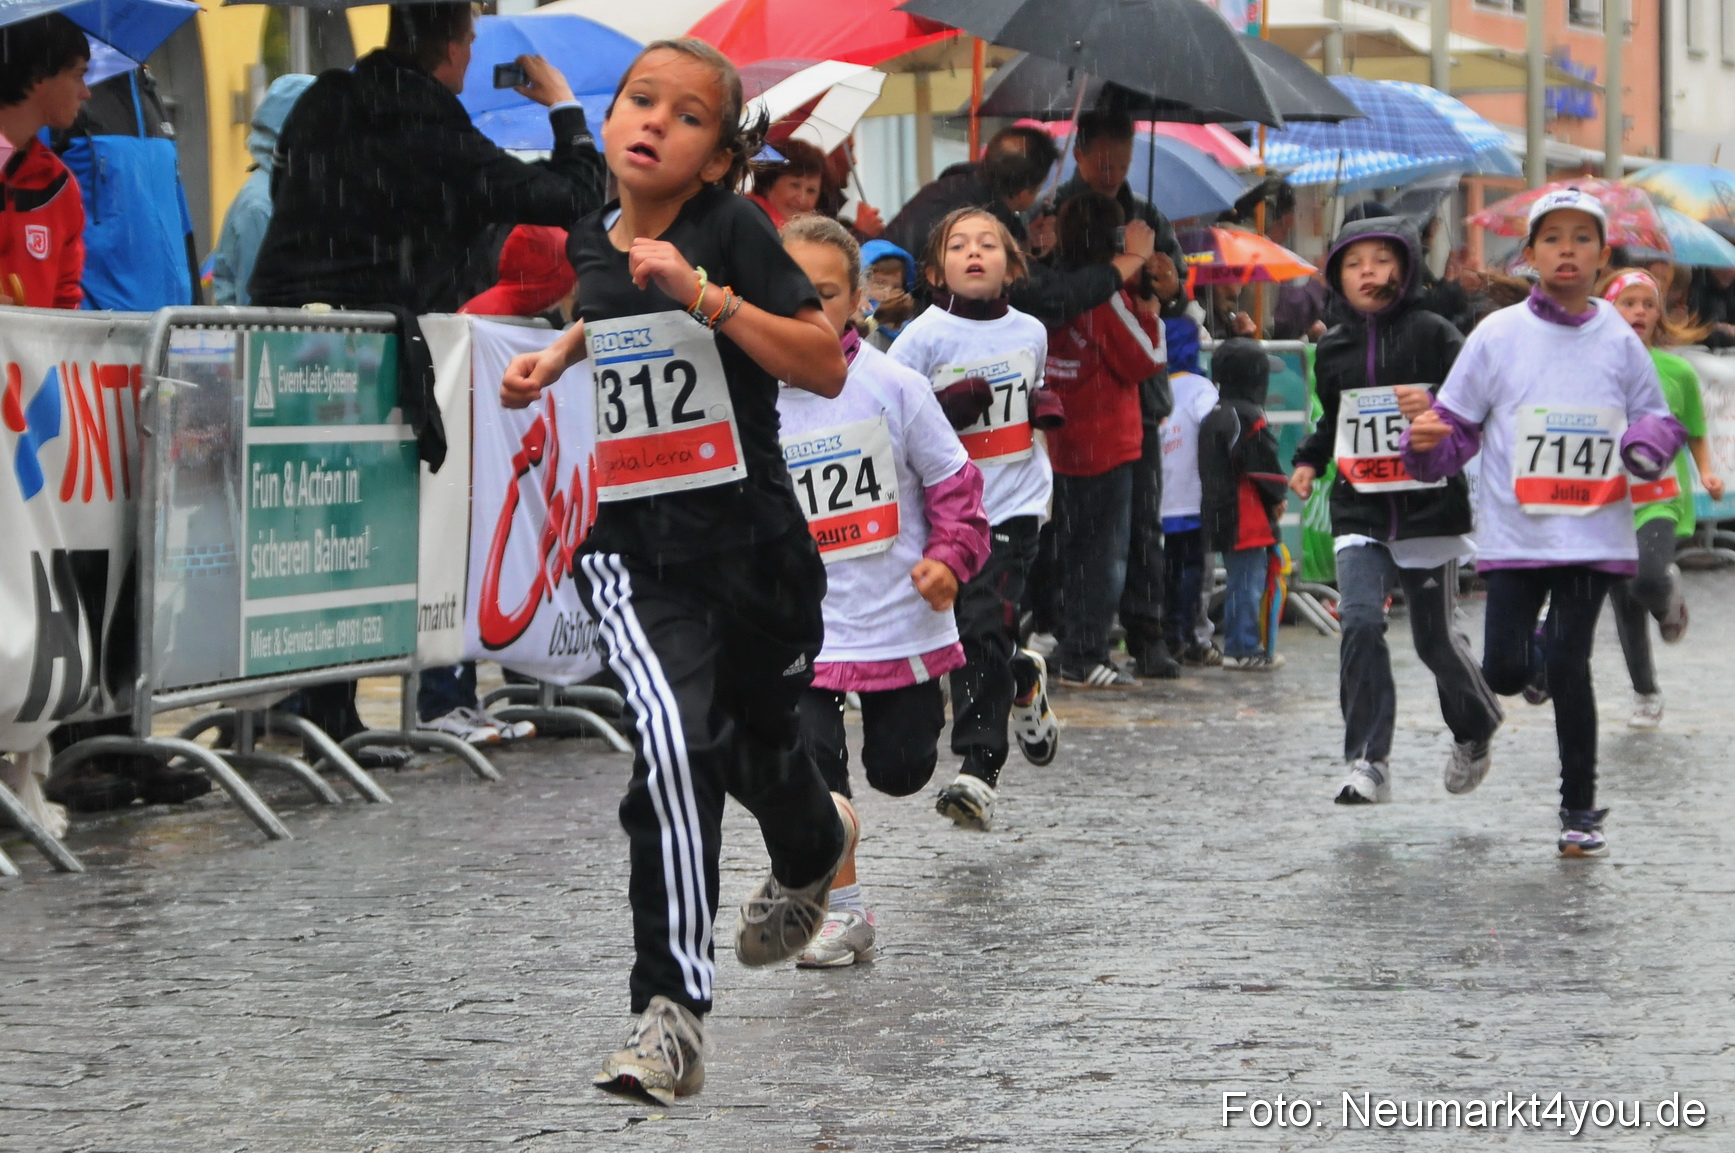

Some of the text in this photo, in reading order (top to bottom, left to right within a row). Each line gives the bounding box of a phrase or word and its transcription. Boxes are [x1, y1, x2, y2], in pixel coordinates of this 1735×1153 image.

[592, 327, 653, 354] BOCK
[278, 363, 357, 400] Event-Leit-Systeme
[965, 360, 1010, 379] BOCK
[785, 434, 842, 460] BOCK
[1526, 435, 1615, 475] 7147
[252, 456, 360, 508] Fun & Action in
[1350, 457, 1406, 479] GRET
[251, 524, 370, 579] sicheren Bahnen!
[283, 623, 312, 654] Service
